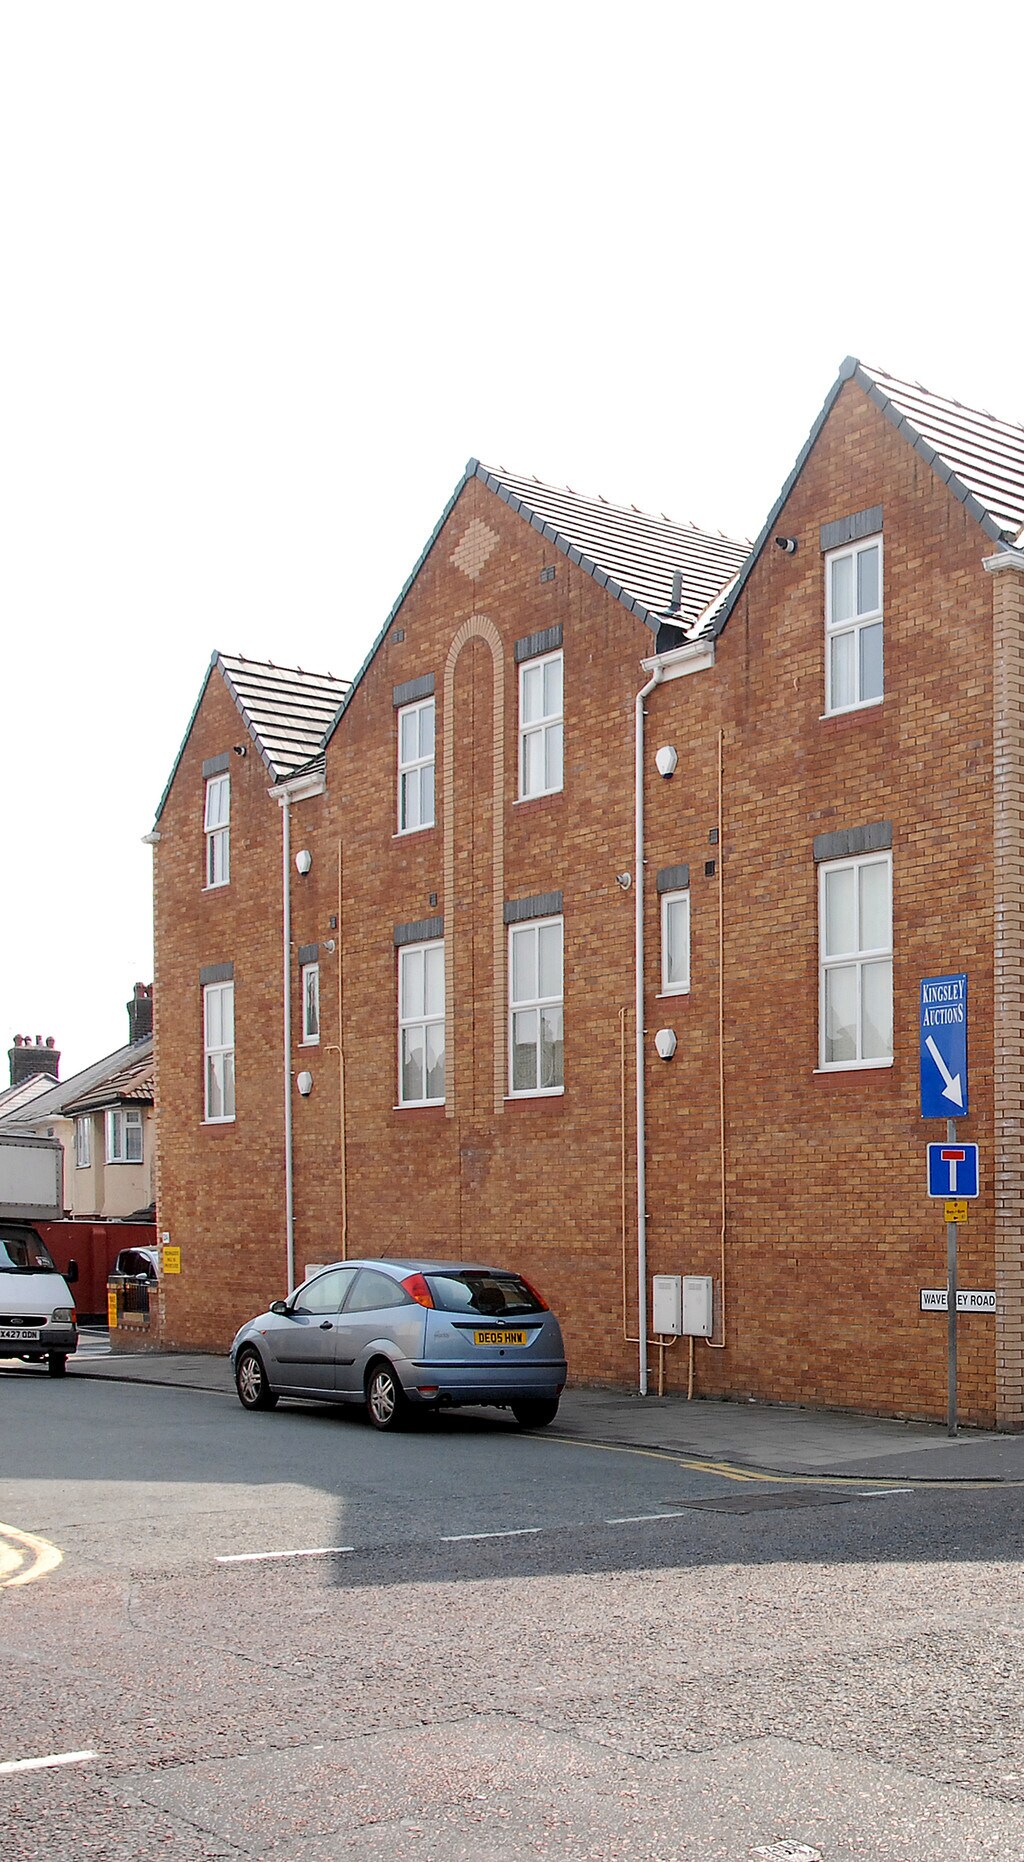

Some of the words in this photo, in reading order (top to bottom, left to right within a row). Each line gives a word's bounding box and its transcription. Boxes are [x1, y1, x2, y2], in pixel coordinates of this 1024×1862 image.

[923, 980, 964, 1003] KINGSLEY
[923, 1003, 963, 1026] AUCTIONS
[924, 1294, 968, 1305] WAVEEY
[971, 1295, 996, 1306] ROAD
[505, 1332, 523, 1343] HNW
